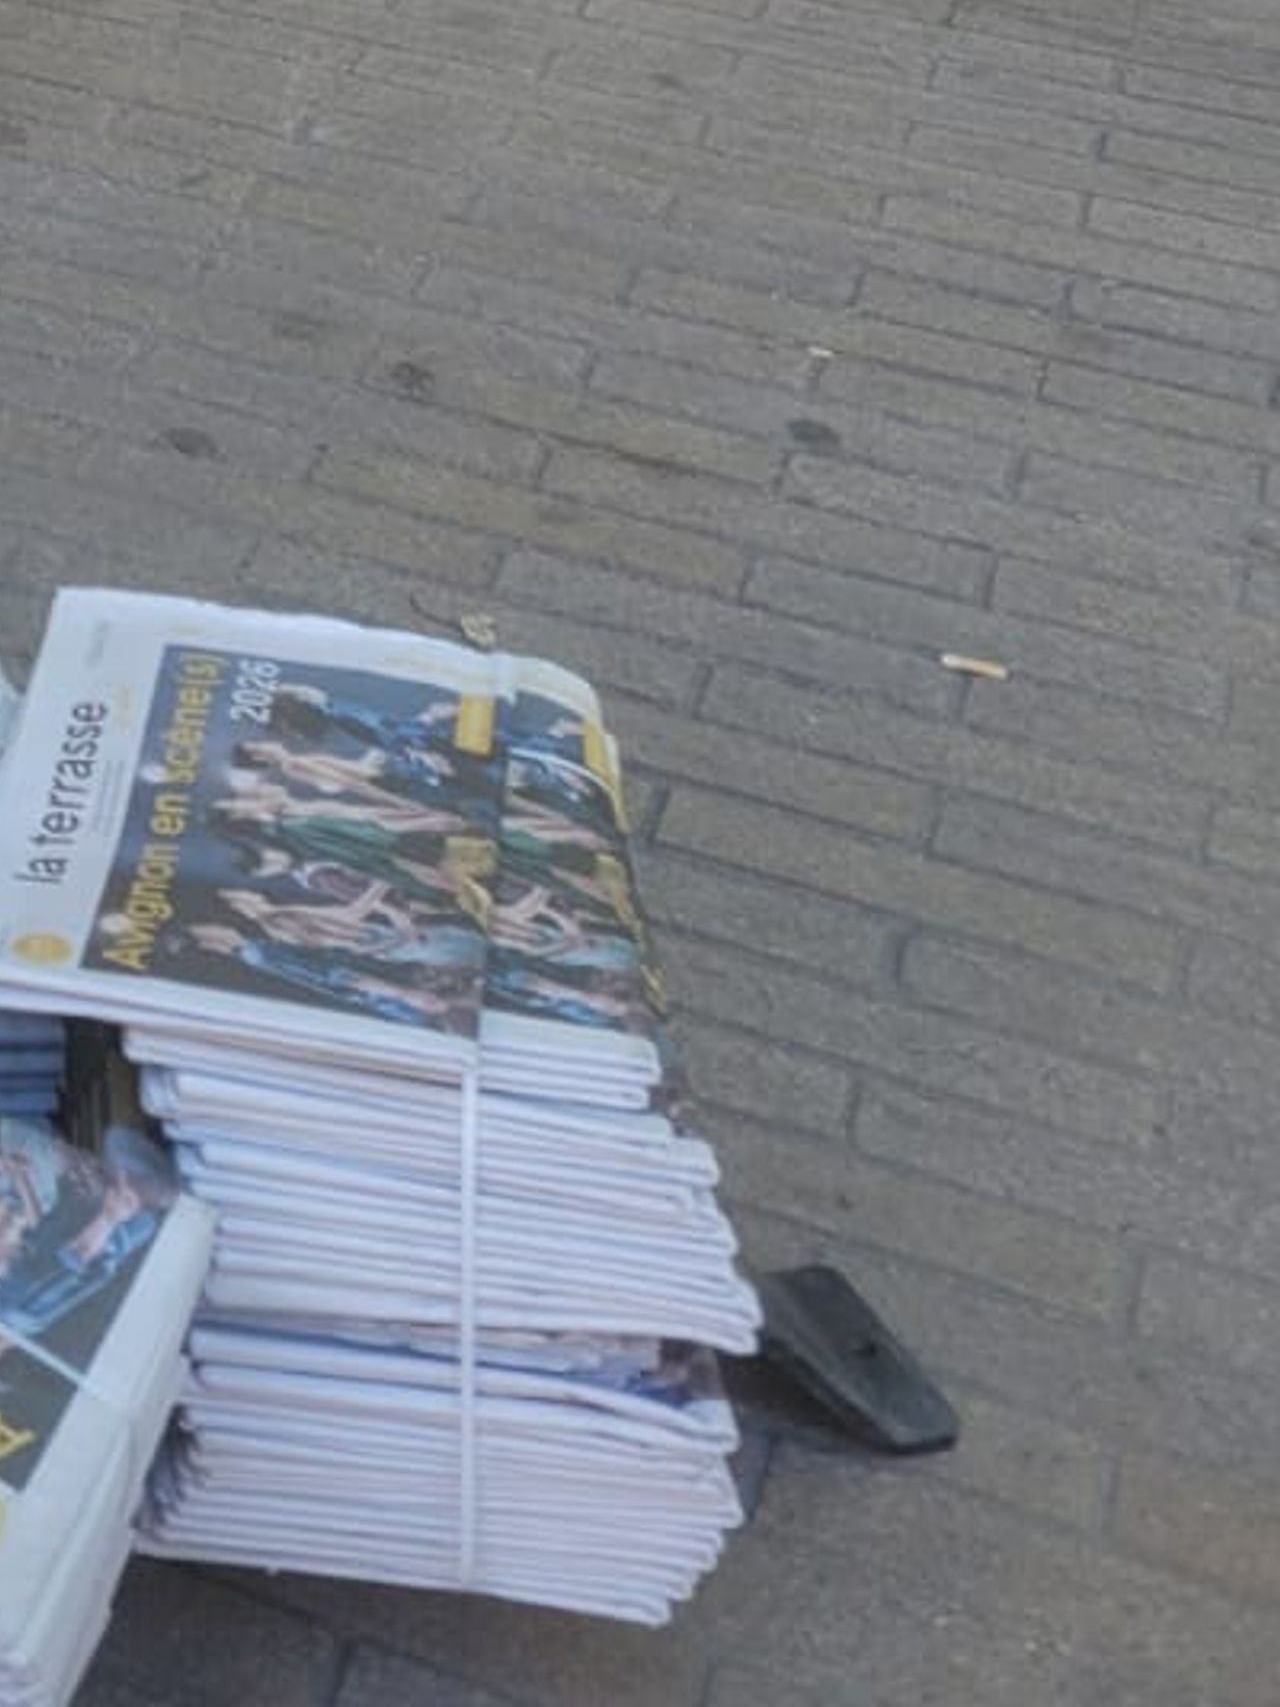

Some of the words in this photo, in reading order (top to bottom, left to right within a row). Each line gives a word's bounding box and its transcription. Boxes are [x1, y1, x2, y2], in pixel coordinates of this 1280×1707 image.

[229, 656, 282, 725] 2026
[29, 699, 109, 855] terrasse
[12, 856, 69, 886] la
[101, 839, 182, 973] Avignon
[150, 791, 191, 836] en
